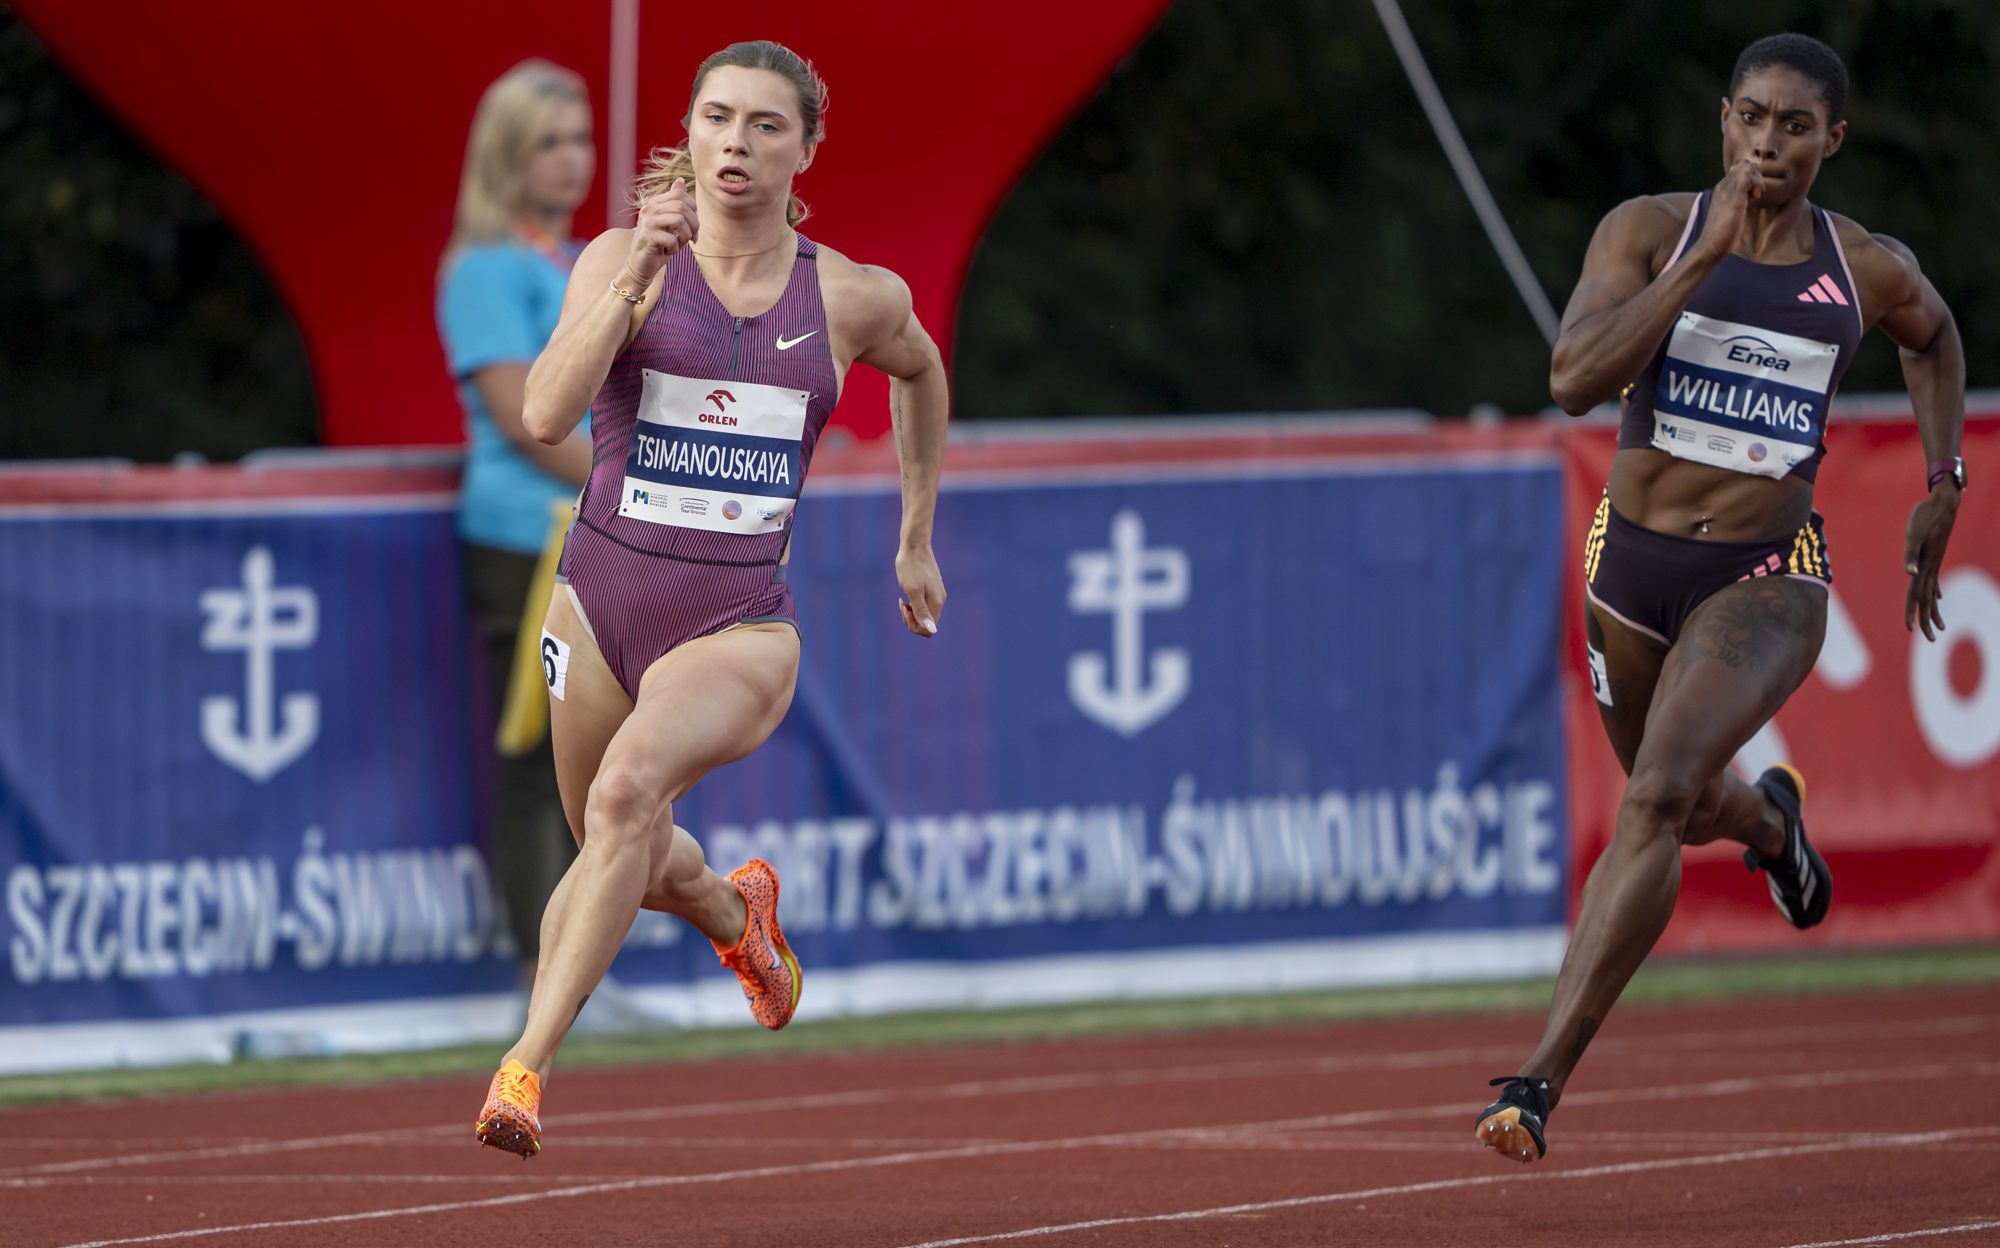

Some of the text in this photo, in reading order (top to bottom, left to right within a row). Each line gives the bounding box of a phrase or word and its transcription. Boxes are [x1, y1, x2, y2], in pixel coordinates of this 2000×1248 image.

[1727, 345, 1791, 372] Enea
[698, 413, 738, 427] ORLEN
[1669, 370, 1813, 433] WILLIAMS
[637, 433, 790, 485] TSIMANOUSKAYA
[541, 636, 560, 688] 6
[6, 826, 680, 985] SZCZECIN-ŚWINO
